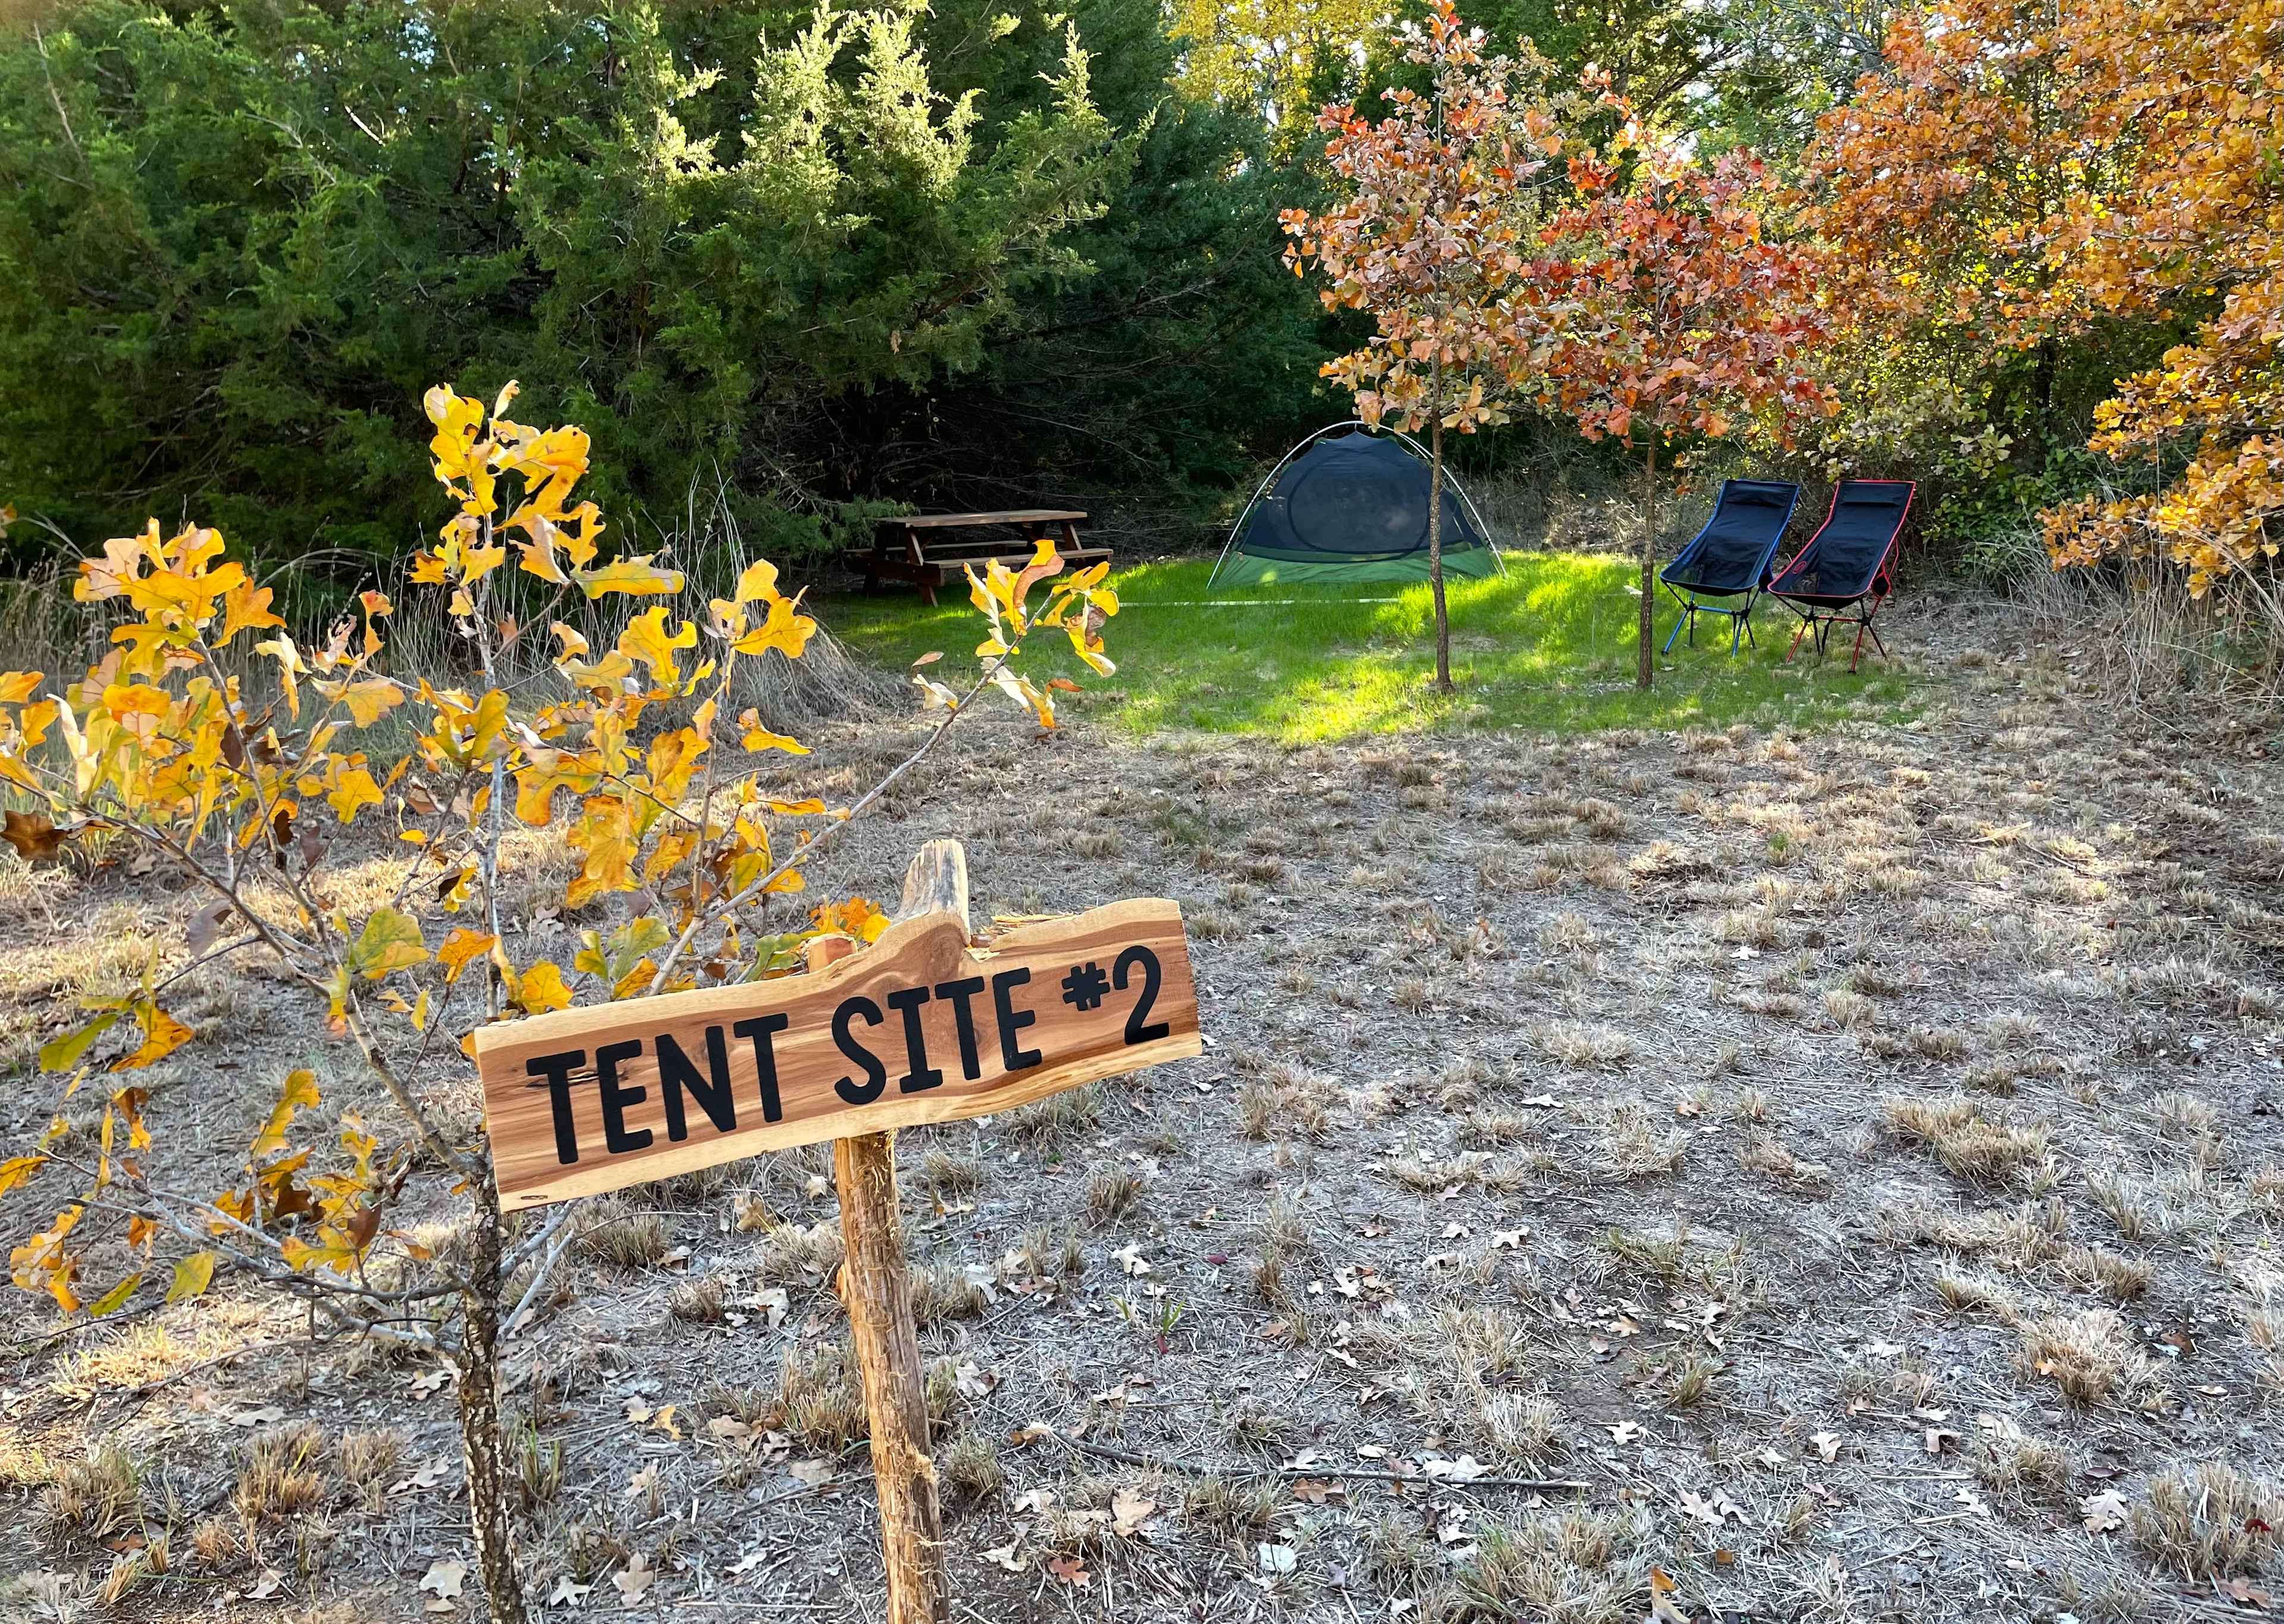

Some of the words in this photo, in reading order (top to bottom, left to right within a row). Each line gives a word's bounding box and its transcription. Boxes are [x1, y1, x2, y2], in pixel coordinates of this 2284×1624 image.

[526, 1013, 788, 1164] TENT
[832, 967, 1043, 1105] SITE
[1061, 945, 1170, 1045] #2
